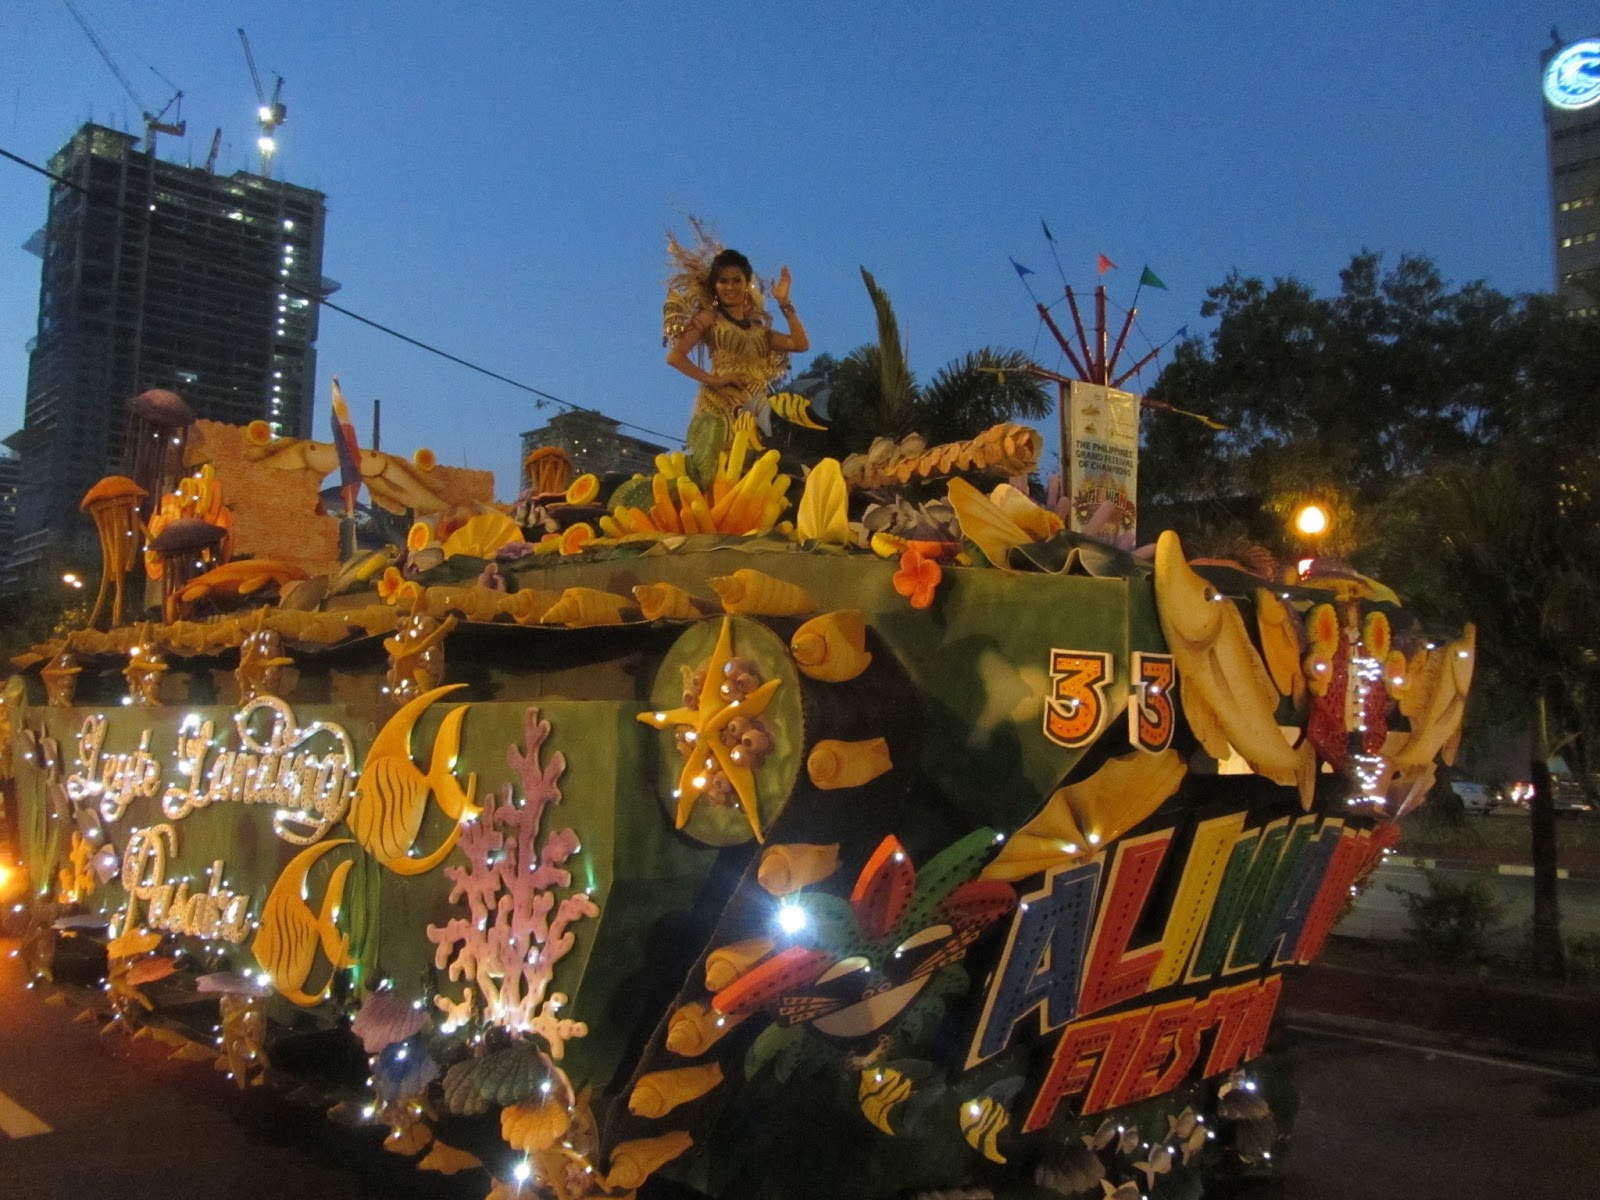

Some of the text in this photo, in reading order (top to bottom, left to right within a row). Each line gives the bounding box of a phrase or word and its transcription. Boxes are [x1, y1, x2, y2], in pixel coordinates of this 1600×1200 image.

[1075, 449, 1134, 469] GRAND FESTIVAL
[1076, 440, 1133, 459] THE PHILIPPINES
[1079, 460, 1131, 477] OF CHAMPIONS
[1021, 972, 1284, 1135] FIESTA
